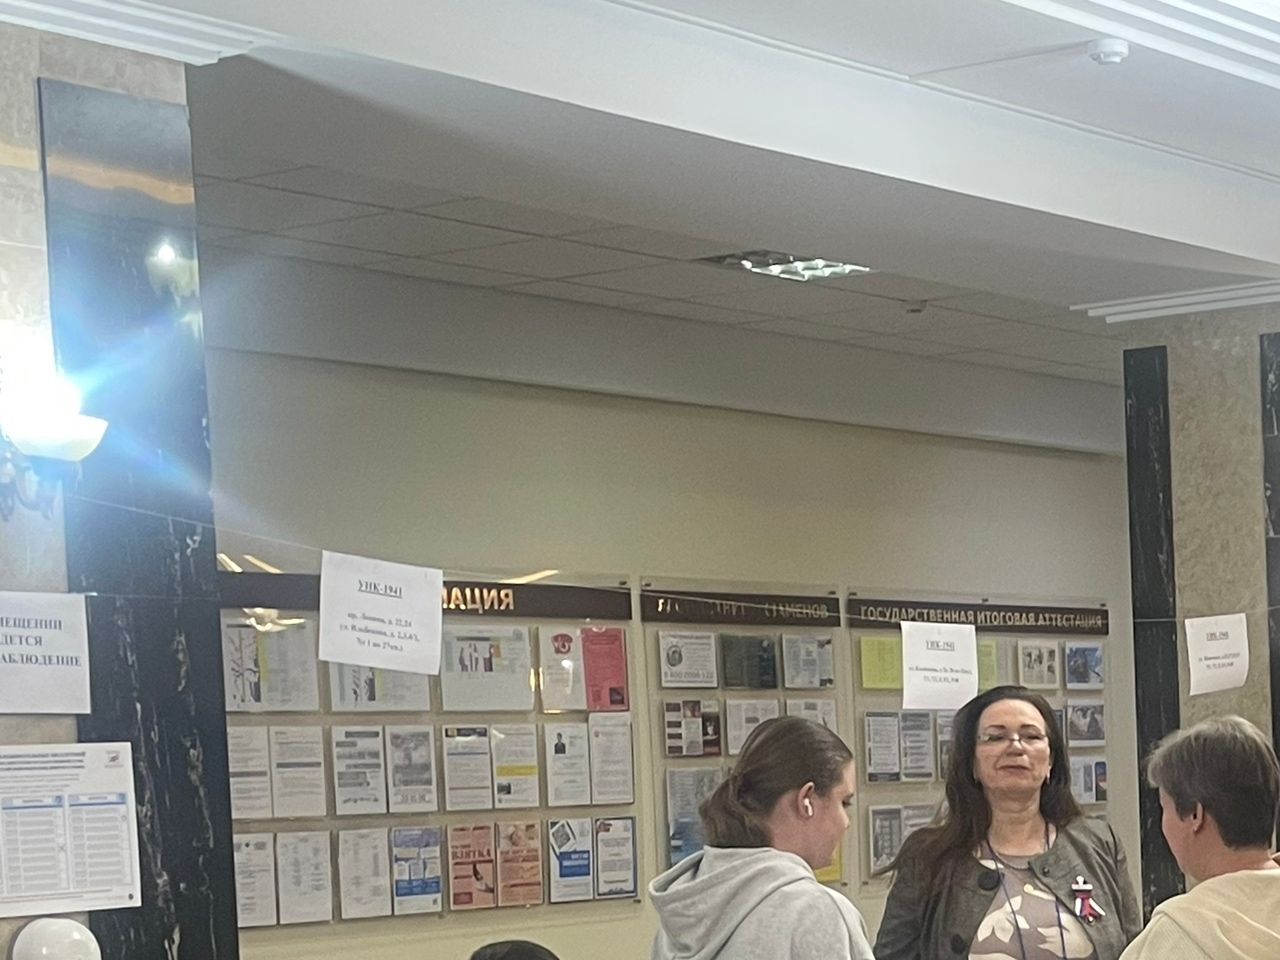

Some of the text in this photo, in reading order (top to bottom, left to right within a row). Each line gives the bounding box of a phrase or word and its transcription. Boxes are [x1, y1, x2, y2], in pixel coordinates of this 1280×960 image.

[860, 605, 1103, 629] ГОСУДАРСТВЕННАЯ ИТОГОВАЯ АТТЕСТАЦИЯ
